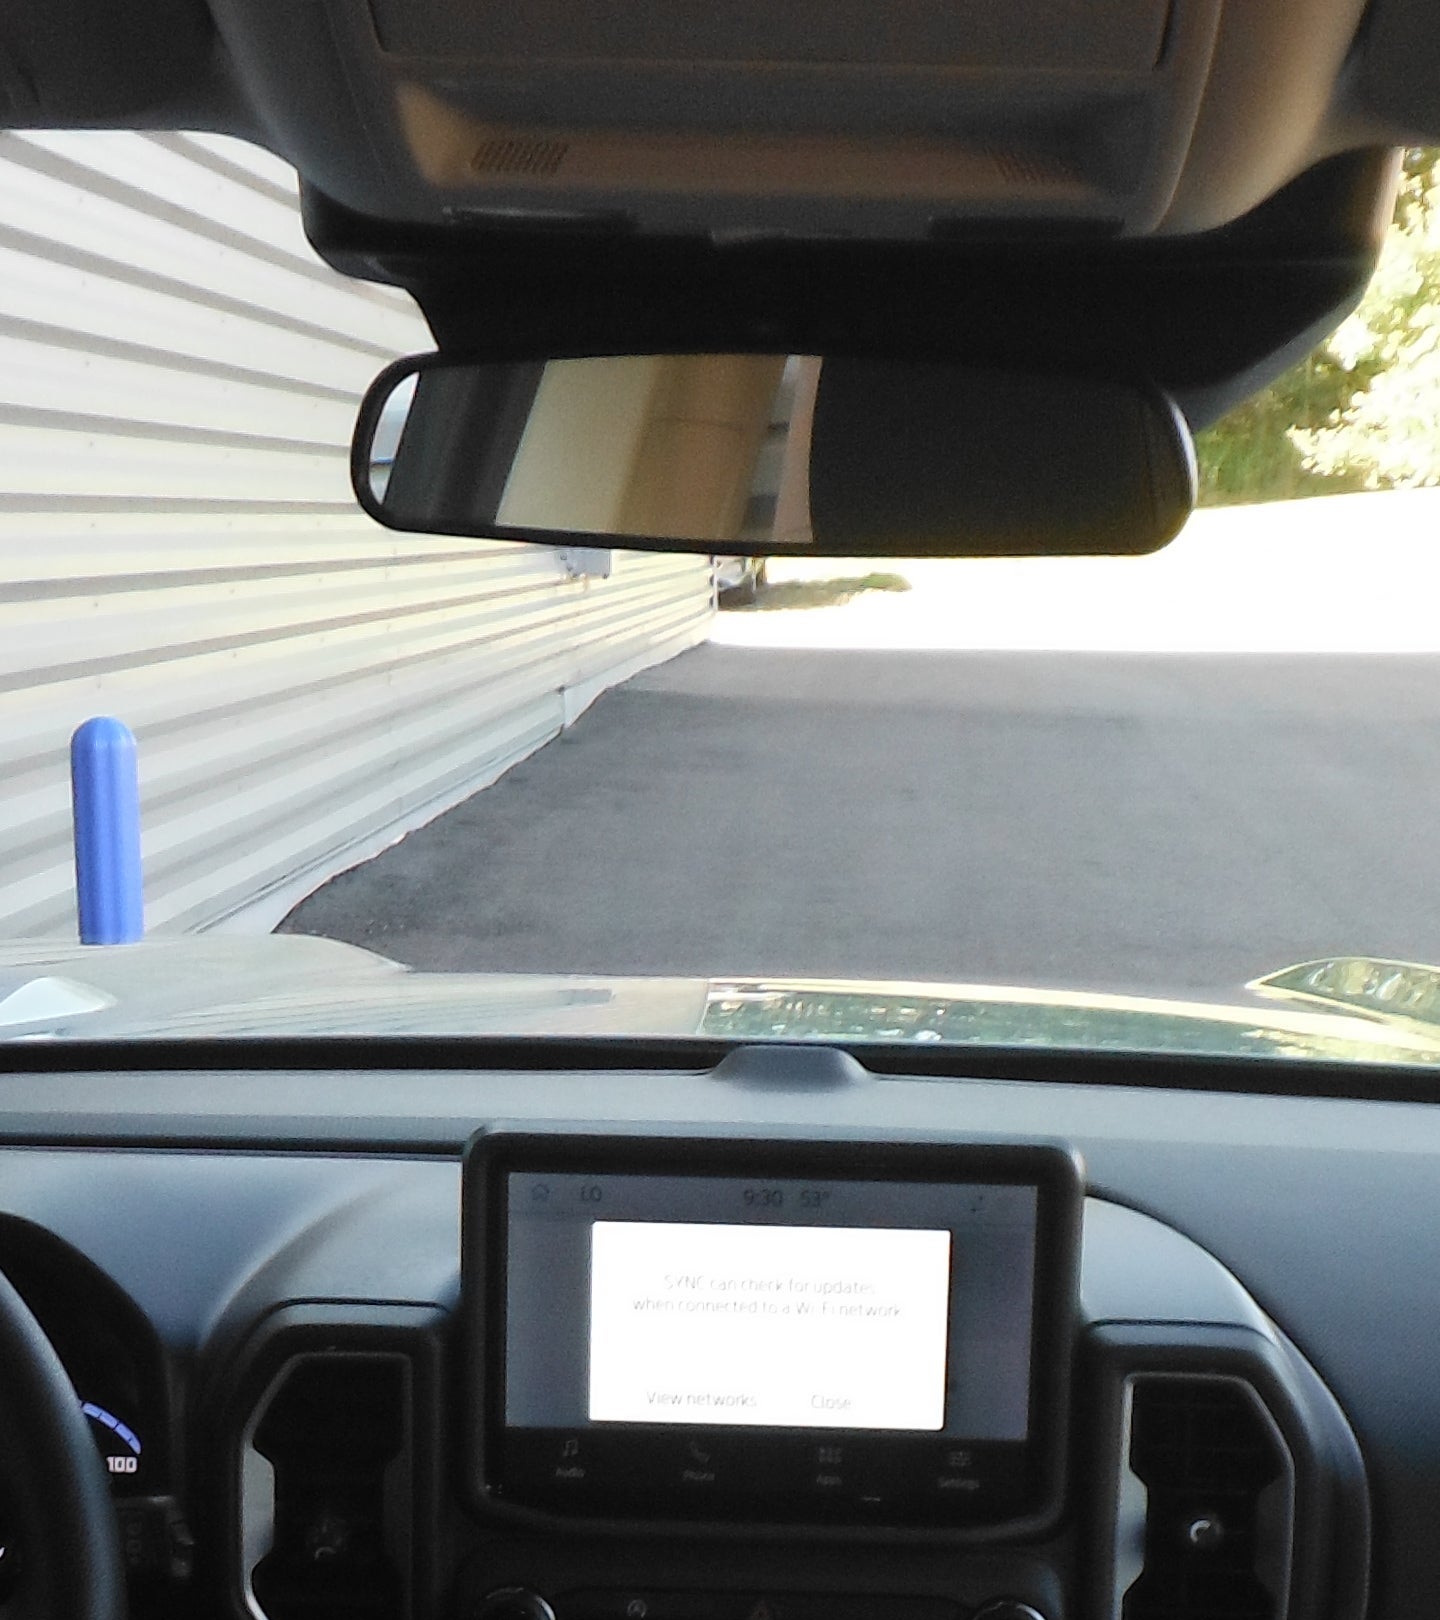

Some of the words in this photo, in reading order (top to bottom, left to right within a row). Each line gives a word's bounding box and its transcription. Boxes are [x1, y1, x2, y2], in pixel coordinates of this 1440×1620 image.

[743, 1188, 784, 1208] 9:30
[800, 1189, 831, 1208] 53°
[664, 1274, 704, 1291] SYNC
[709, 1280, 738, 1292] can
[741, 1278, 784, 1293] check
[789, 1278, 809, 1293] for
[813, 1280, 877, 1297] updates
[633, 1297, 674, 1311] when
[678, 1299, 758, 1314] connected
[762, 1302, 778, 1314] to
[782, 1305, 791, 1315] a
[646, 1391, 683, 1407] View
[686, 1392, 758, 1408] networks
[810, 1393, 852, 1410] Close
[107, 1456, 138, 1473] 100
